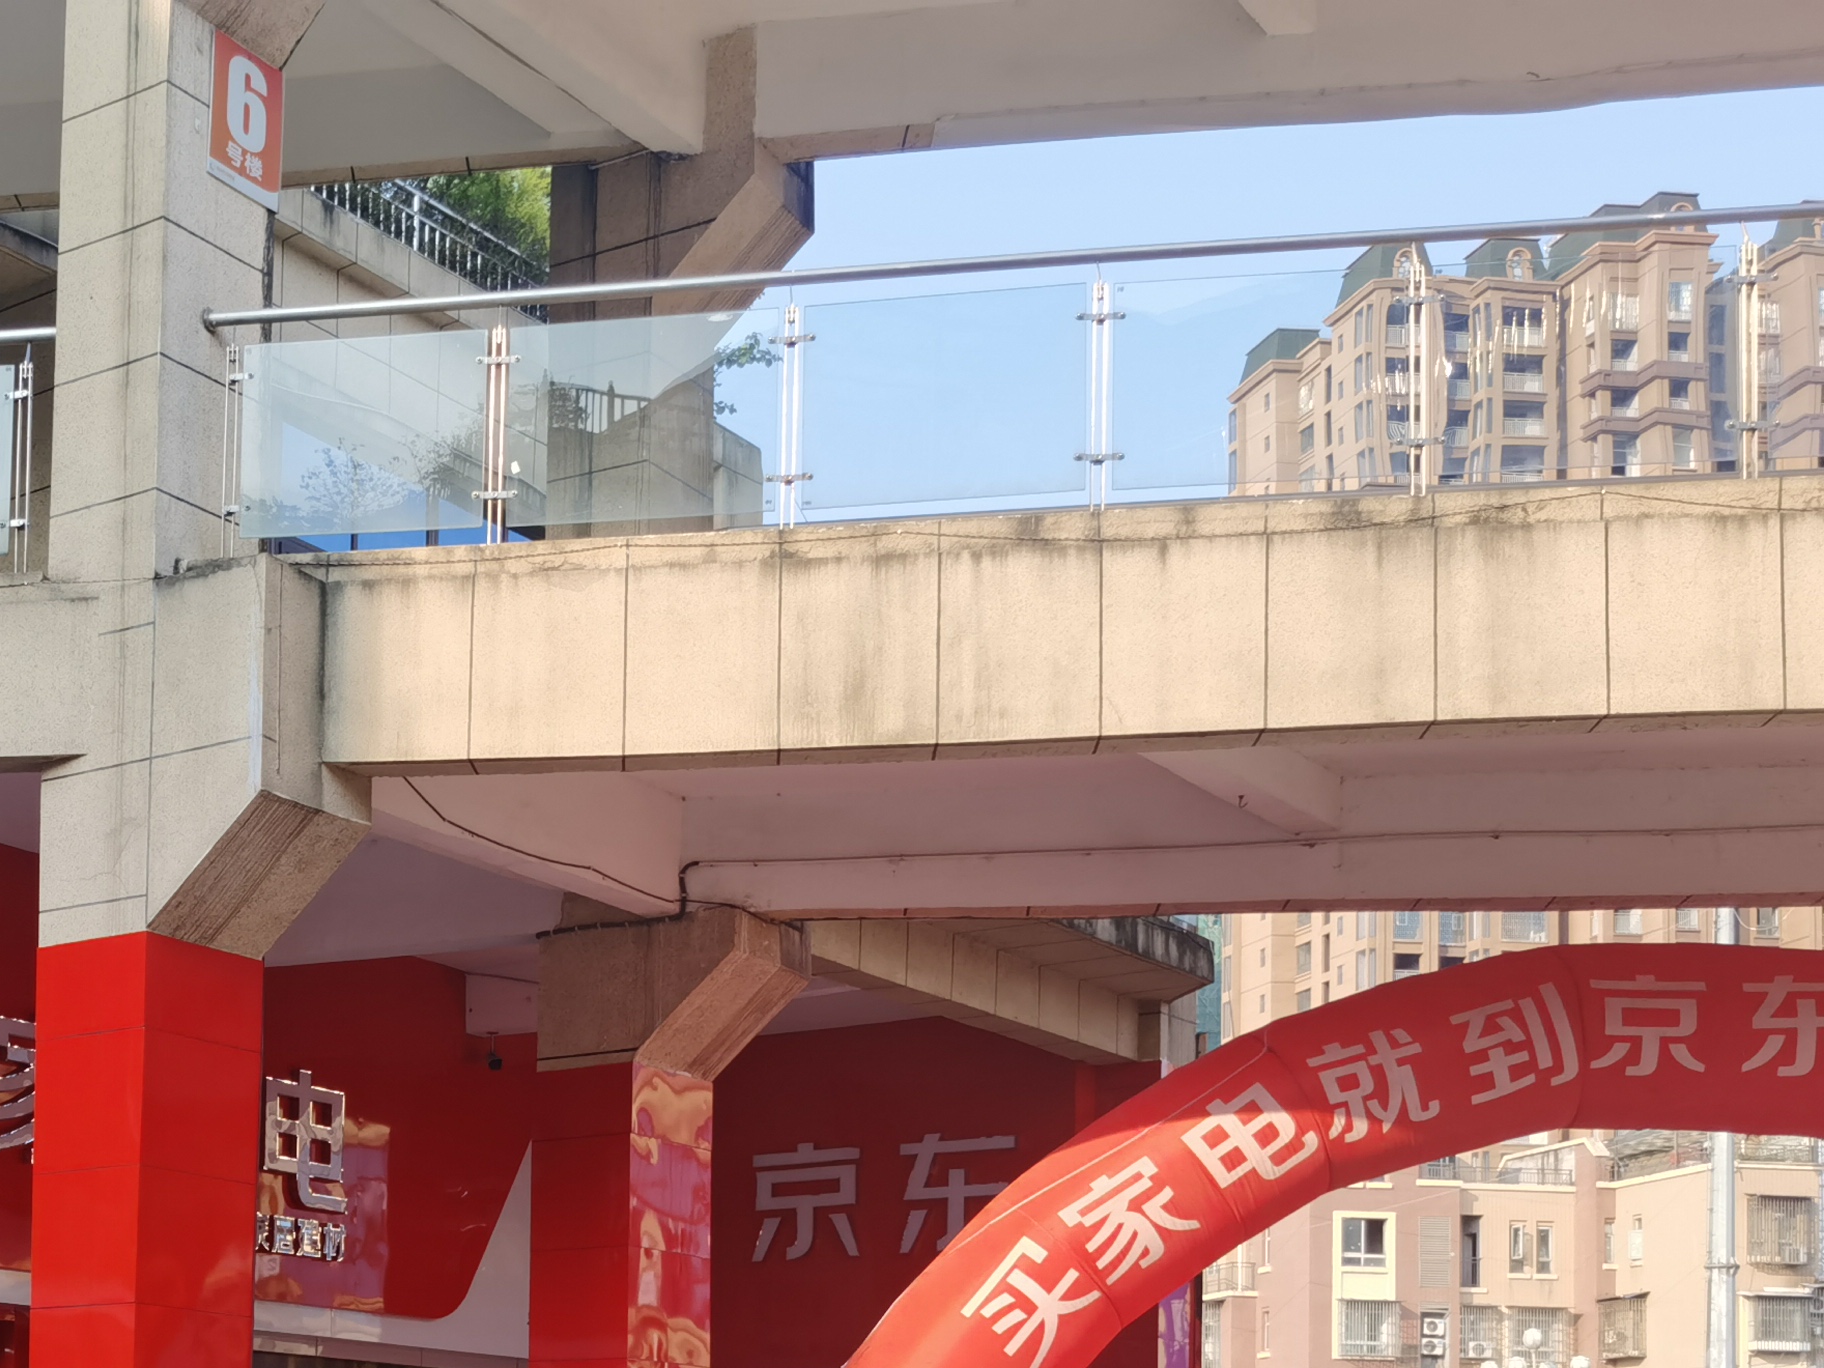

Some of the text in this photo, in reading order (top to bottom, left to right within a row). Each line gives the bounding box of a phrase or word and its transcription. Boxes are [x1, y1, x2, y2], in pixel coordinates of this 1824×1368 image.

[227, 55, 268, 153] 6
[226, 141, 264, 182] 号楼
[752, 1133, 1018, 1263] 京东
